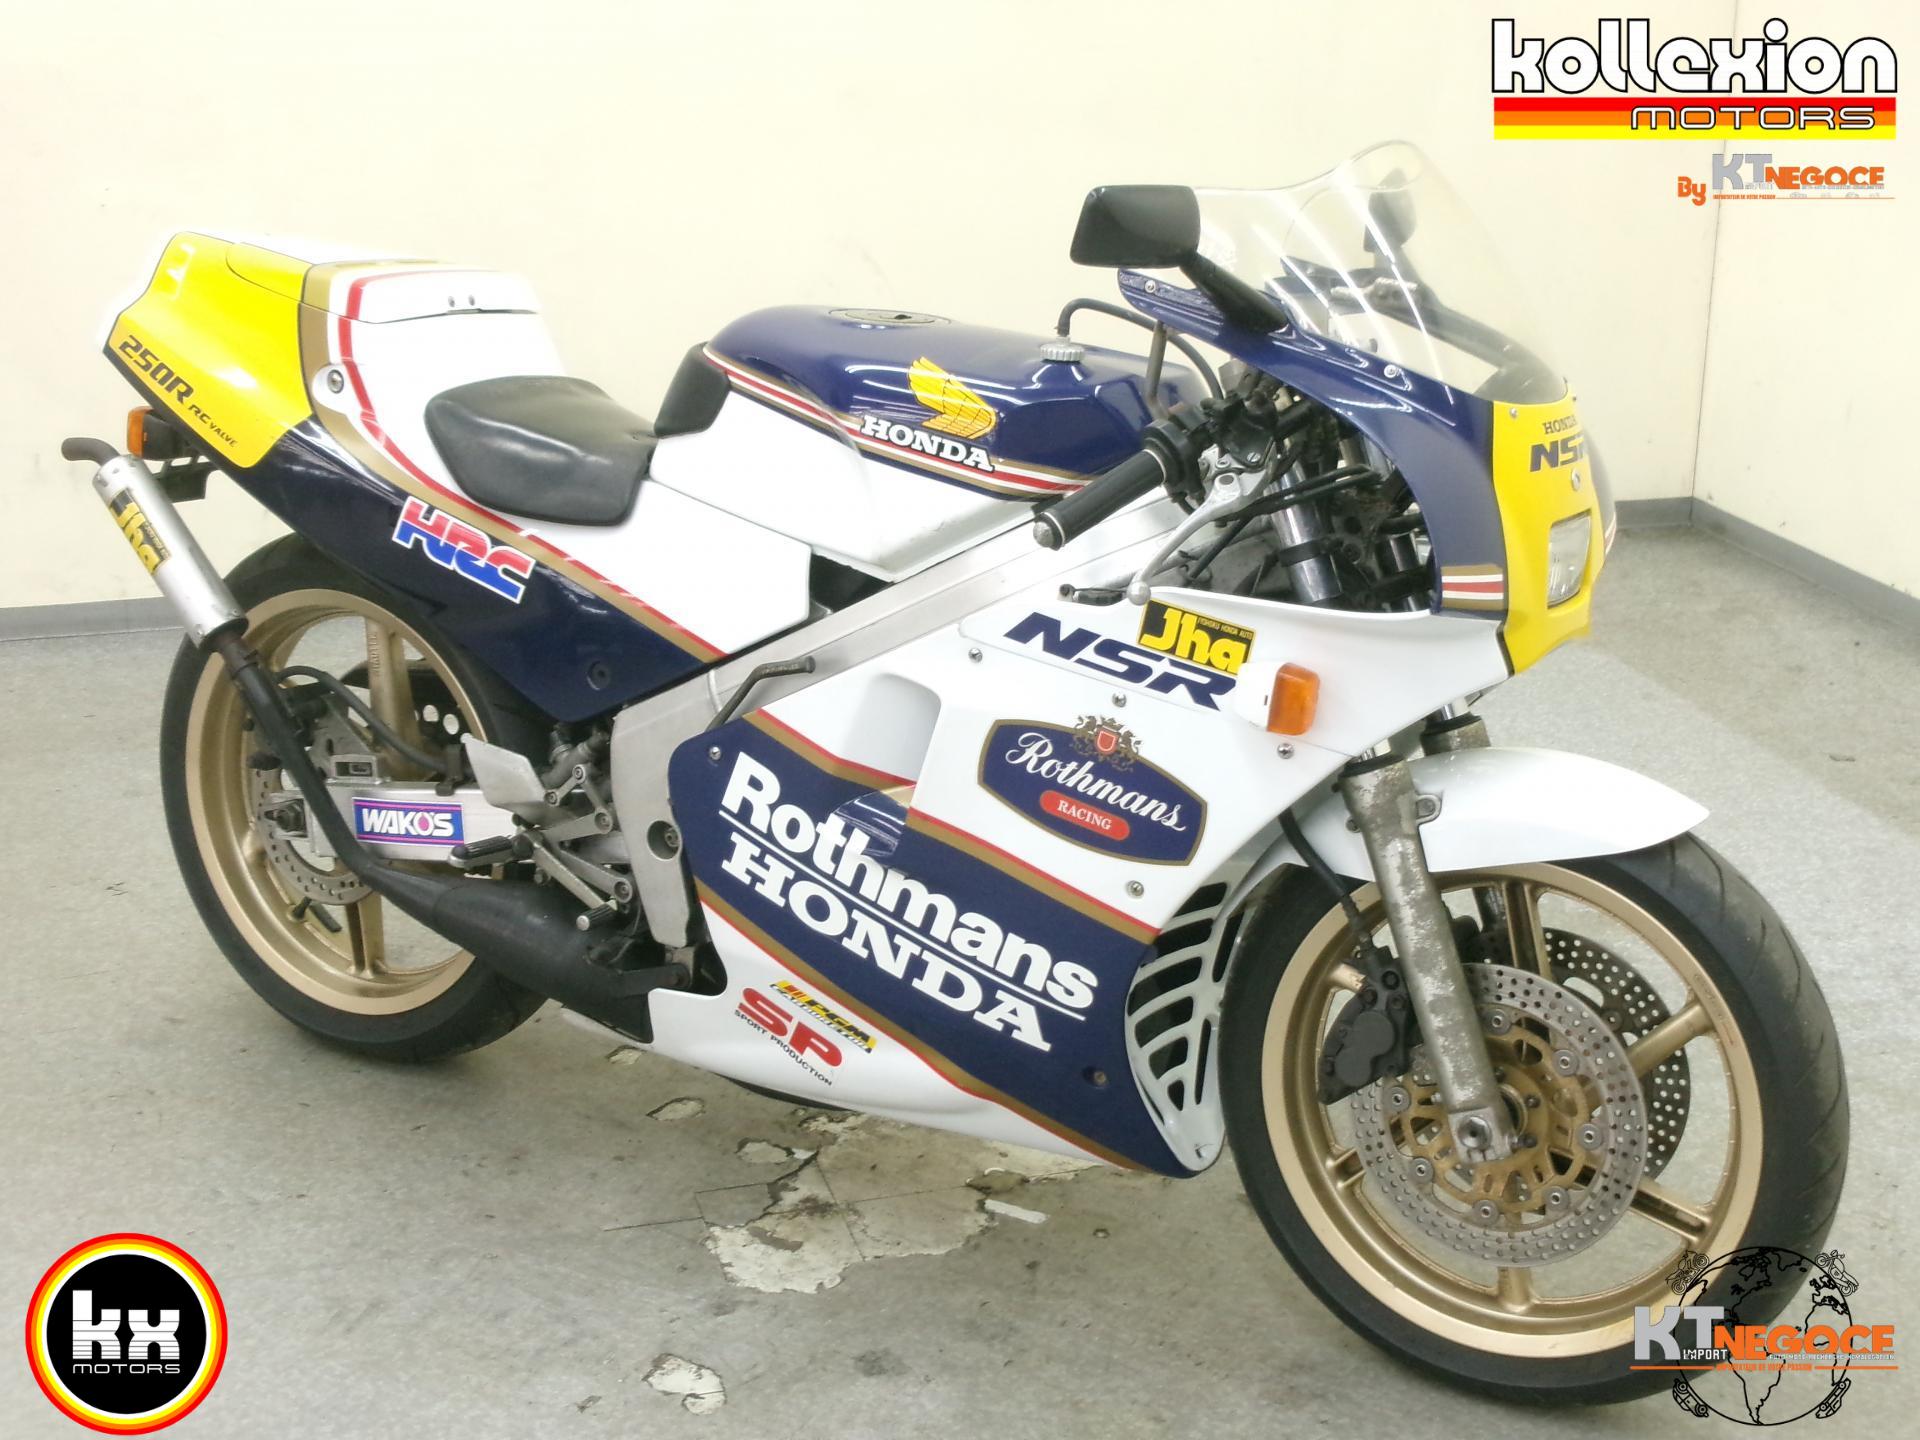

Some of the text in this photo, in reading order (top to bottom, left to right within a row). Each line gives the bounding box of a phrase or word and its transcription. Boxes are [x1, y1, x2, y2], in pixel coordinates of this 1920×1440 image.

[118, 334, 238, 448] 250R RC VALVE
[860, 414, 995, 473] HONDA
[391, 495, 537, 605] HRC
[1003, 611, 1237, 711] NSR
[1139, 607, 1247, 675] Jha
[1005, 732, 1187, 831] Rothmans
[1056, 799, 1113, 831] RACING
[721, 751, 1099, 1010] Rothmans
[721, 832, 1052, 1052] HONDA
[734, 1009, 768, 1036] SPORT
[770, 1034, 833, 1087] PRODUCTION
[738, 987, 843, 1068] SP
